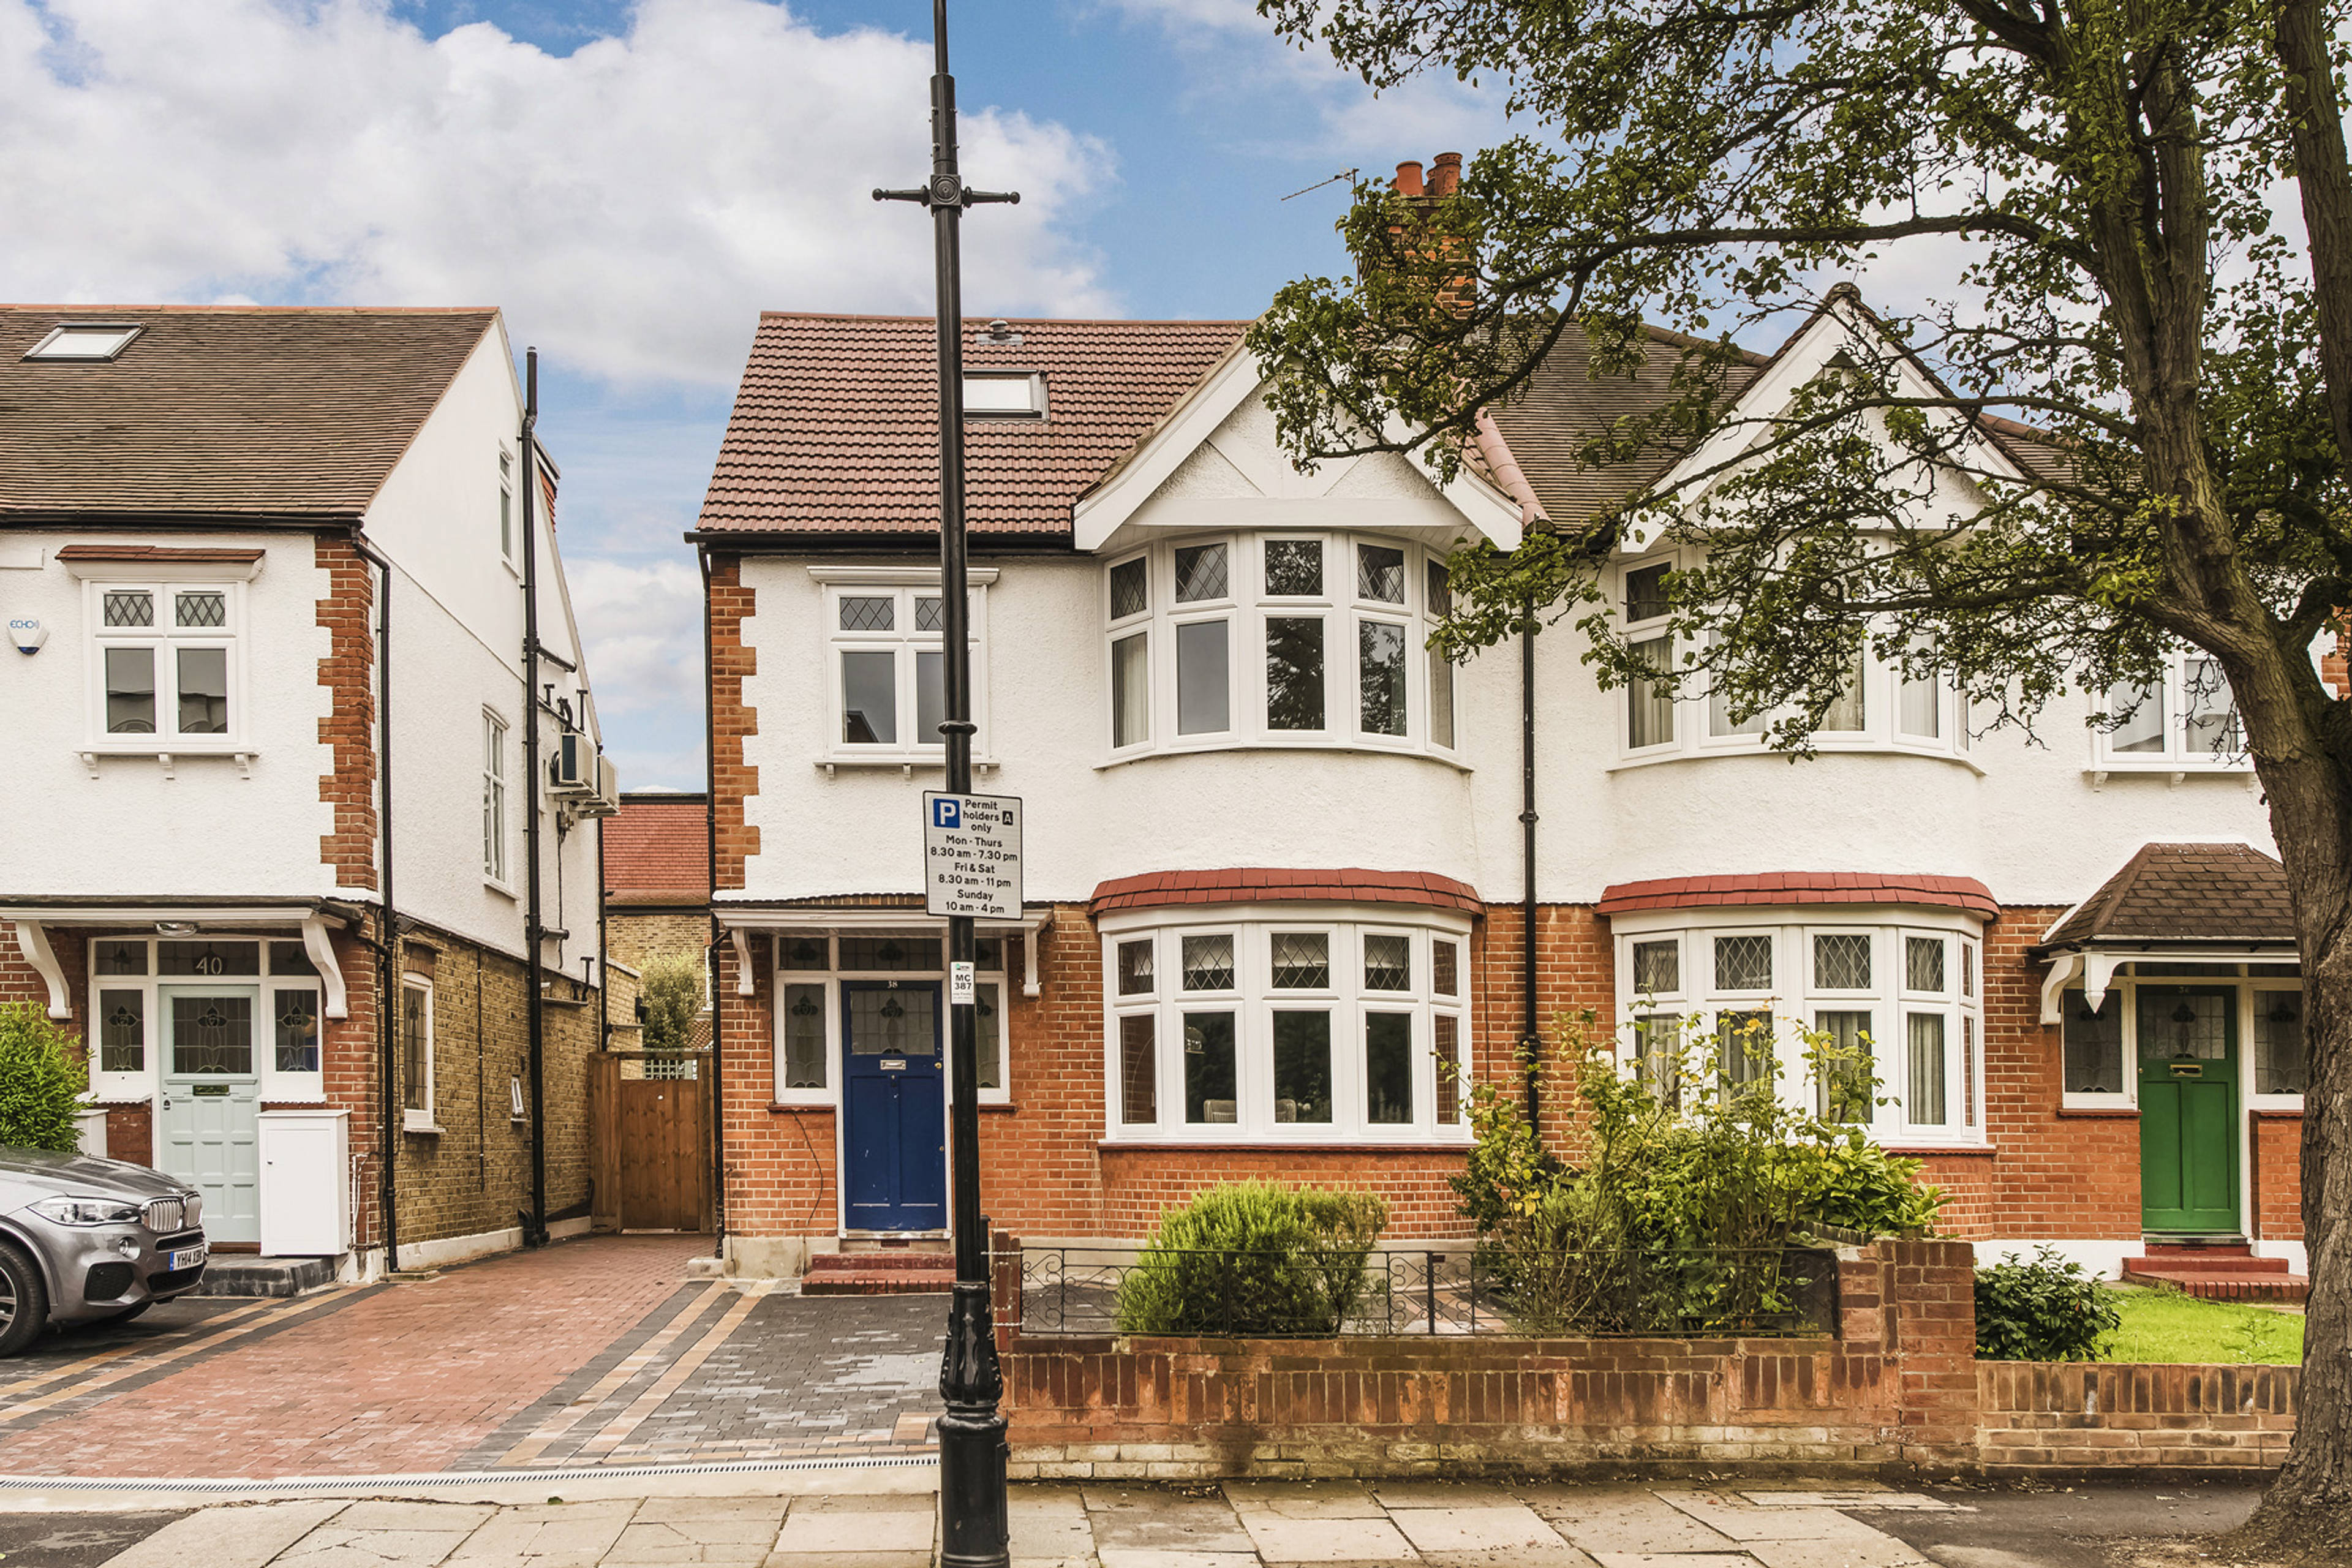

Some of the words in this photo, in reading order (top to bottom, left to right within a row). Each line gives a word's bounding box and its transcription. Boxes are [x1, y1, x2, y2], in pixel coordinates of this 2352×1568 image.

[965, 799, 998, 810] Permit
[940, 802, 956, 825] P
[963, 810, 1000, 821] holders
[1004, 813, 1011, 823] A
[971, 823, 992, 834] only
[946, 835, 967, 845] Mon
[974, 837, 1003, 847] Thurs
[930, 846, 954, 856] 8.30
[979, 850, 1001, 860] 7.30
[1003, 853, 1017, 862] pm
[955, 862, 968, 872] Fri
[970, 864, 976, 872] &
[978, 864, 995, 873] Sat
[938, 874, 962, 884] 8.30
[986, 877, 994, 886] 11
[957, 889, 993, 902] Sunday
[946, 902, 957, 910] 10
[981, 903, 987, 912] 4
[195, 956, 222, 974] 40
